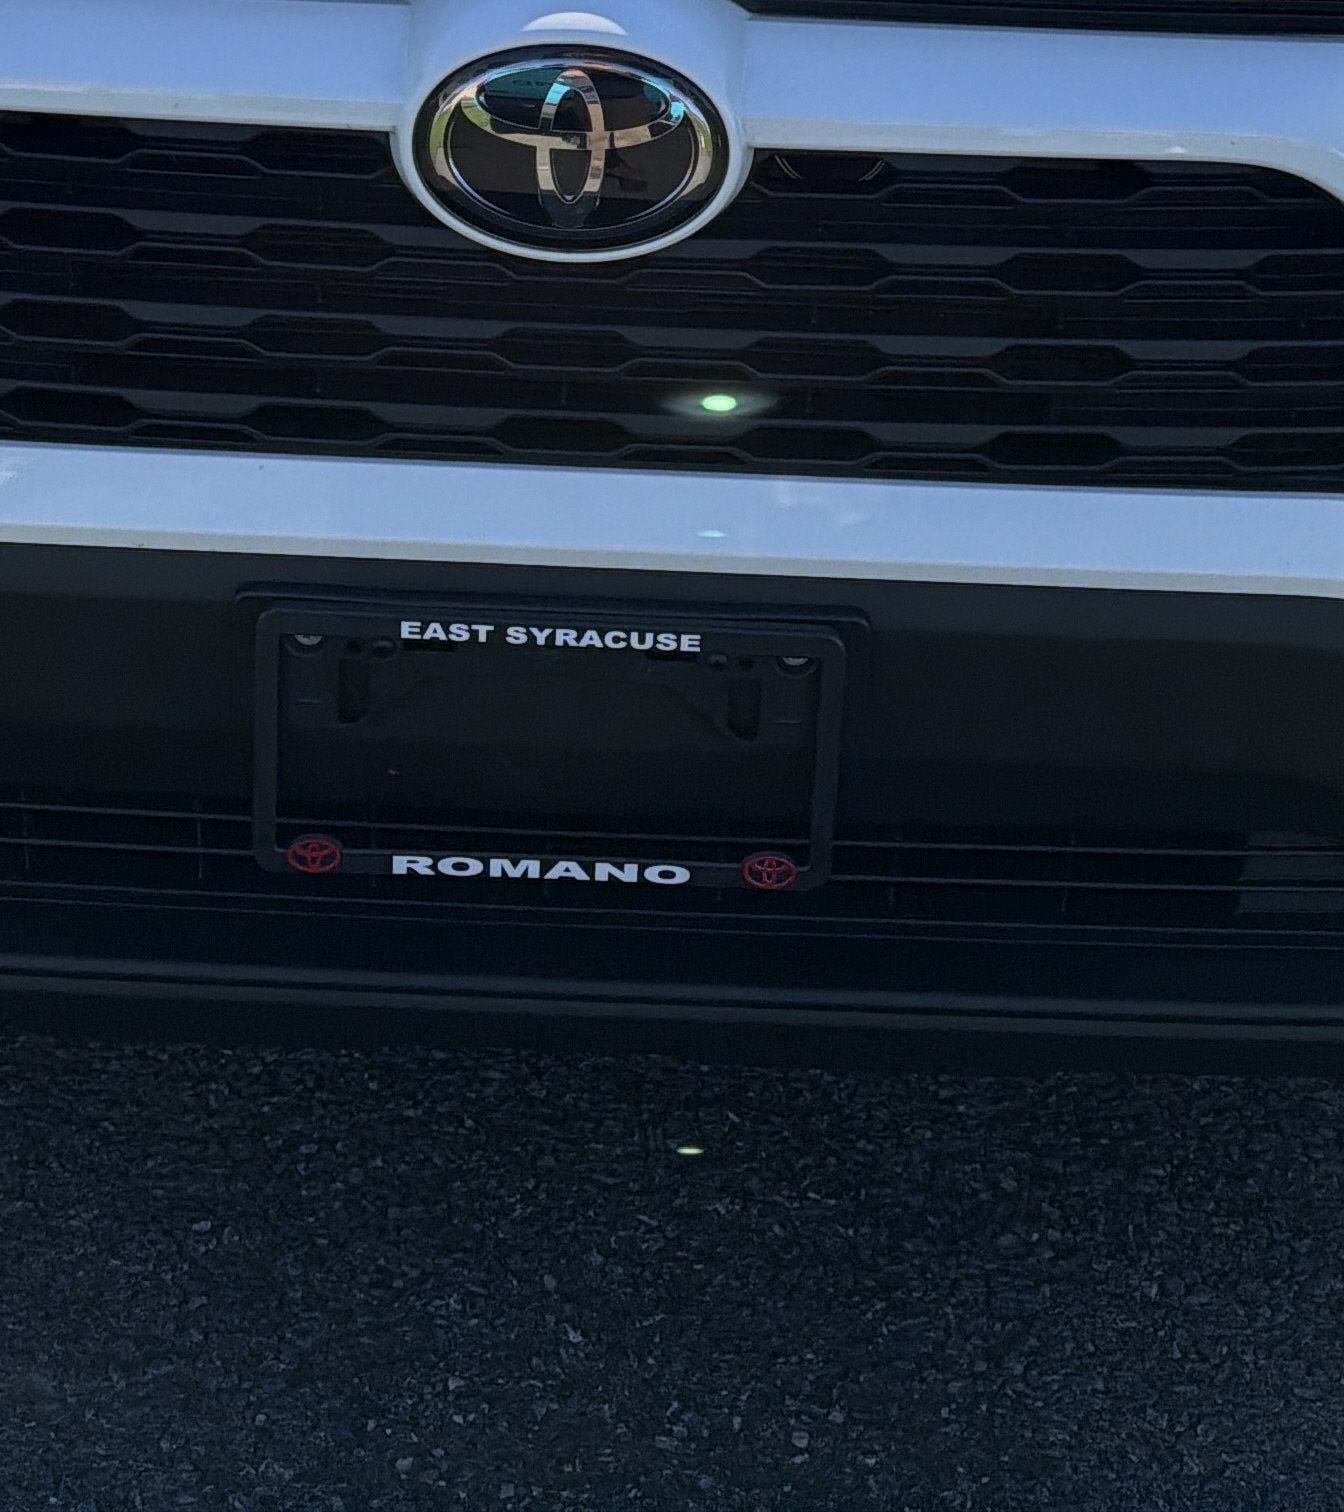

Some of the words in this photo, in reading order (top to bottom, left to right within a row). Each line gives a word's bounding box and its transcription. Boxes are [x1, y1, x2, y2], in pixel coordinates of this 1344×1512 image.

[400, 620, 495, 643] EAST
[505, 626, 701, 652] SYRACUSE
[392, 855, 691, 885] ROMANO
